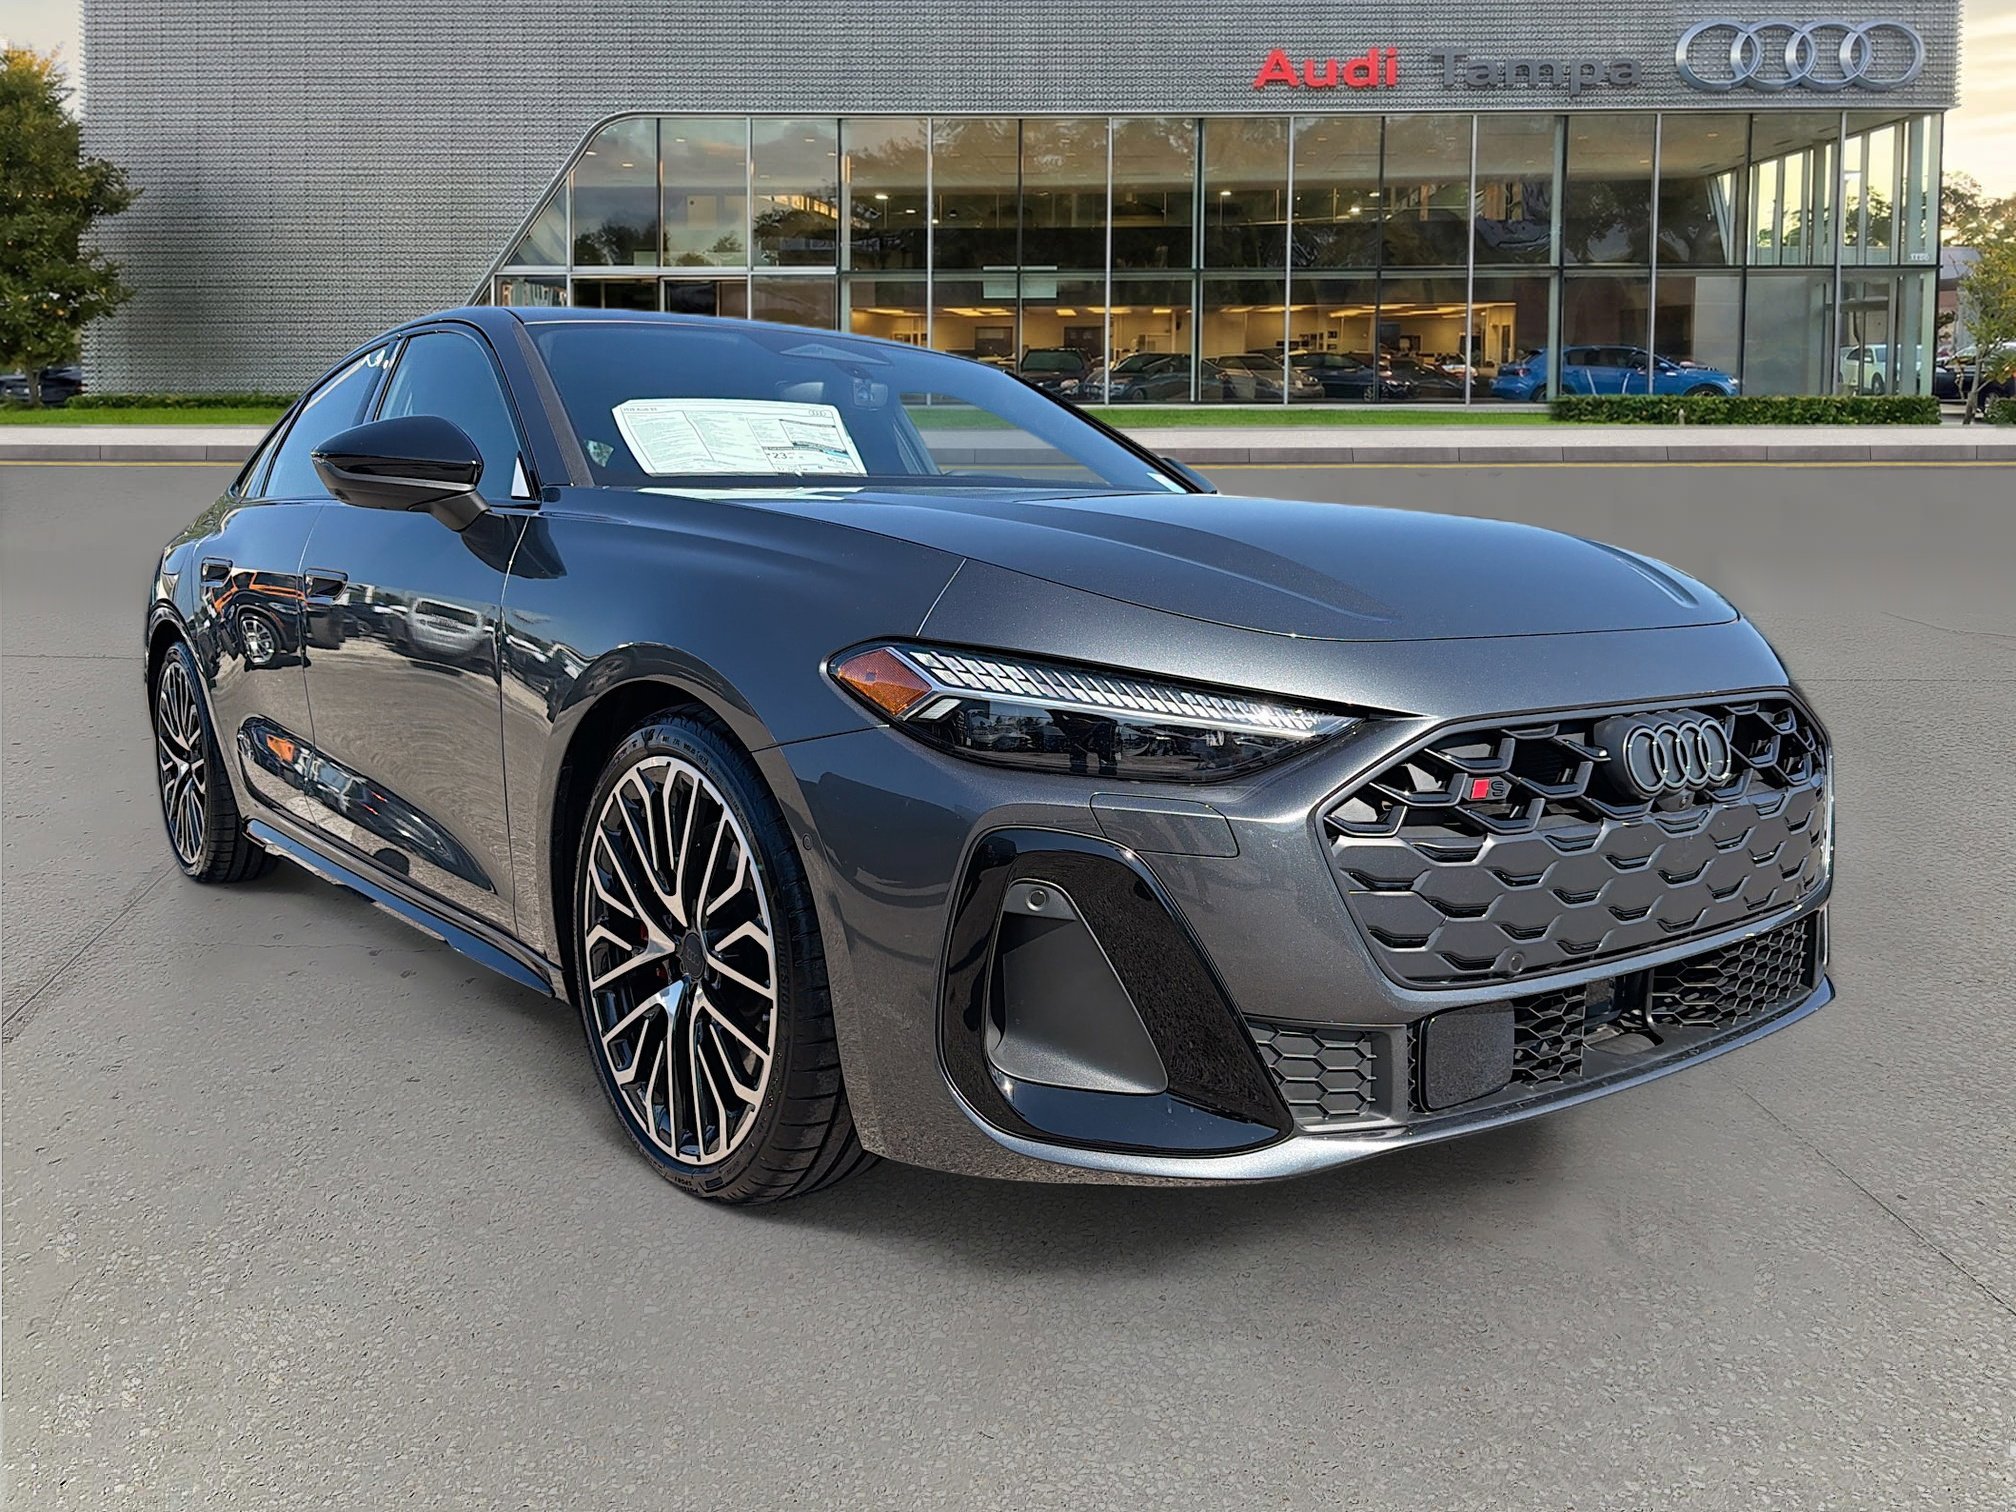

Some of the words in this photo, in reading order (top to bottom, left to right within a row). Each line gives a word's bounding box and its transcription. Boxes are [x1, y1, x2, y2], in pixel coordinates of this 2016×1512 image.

[1253, 47, 1398, 90] Audi
[1431, 48, 1643, 97] Tampa
[1490, 780, 1505, 797] S
